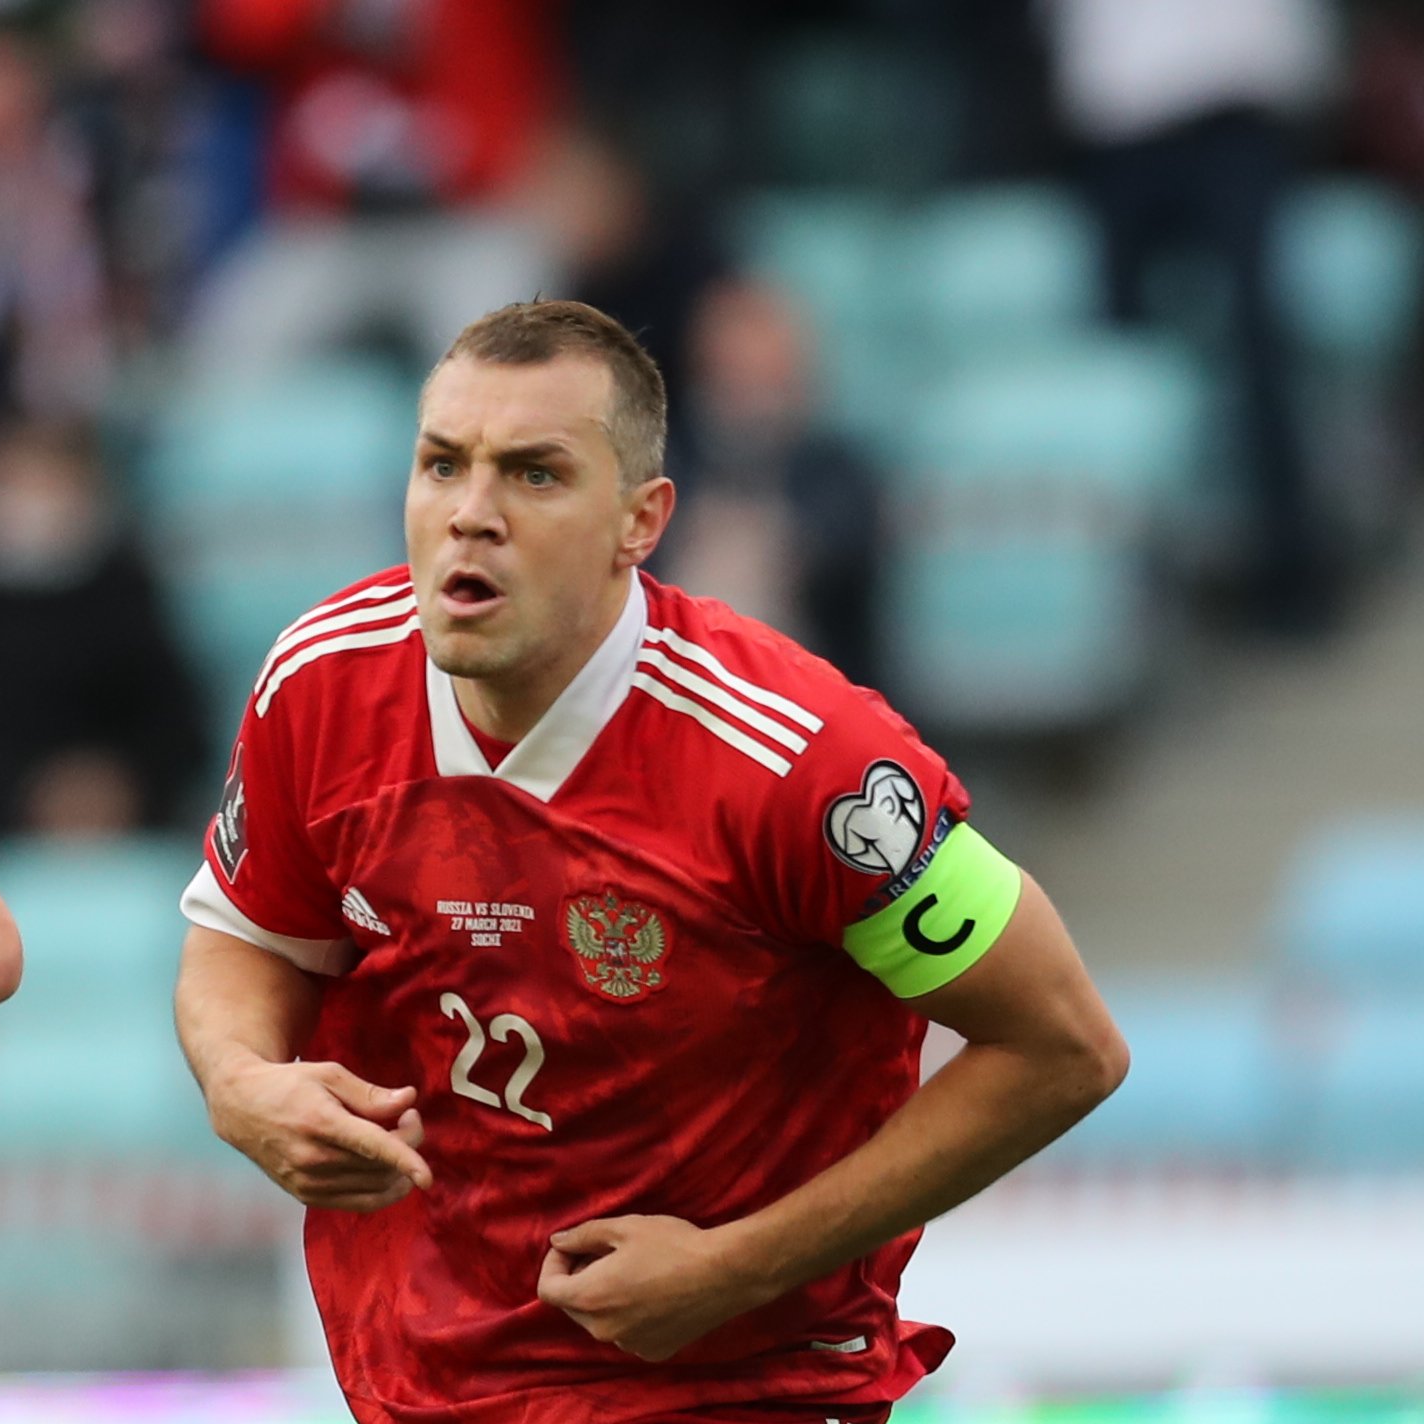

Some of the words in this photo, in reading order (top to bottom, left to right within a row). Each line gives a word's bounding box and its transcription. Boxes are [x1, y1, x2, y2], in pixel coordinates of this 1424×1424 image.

[437, 900, 472, 915] RUSSIA
[475, 902, 488, 915] VS
[490, 903, 535, 920] SLOVENIA
[451, 918, 464, 930] 27
[465, 918, 497, 931] MARCH
[499, 919, 522, 932] 2021
[902, 893, 975, 956] C
[471, 933, 501, 946] SOCHI
[440, 991, 553, 1132] 22
